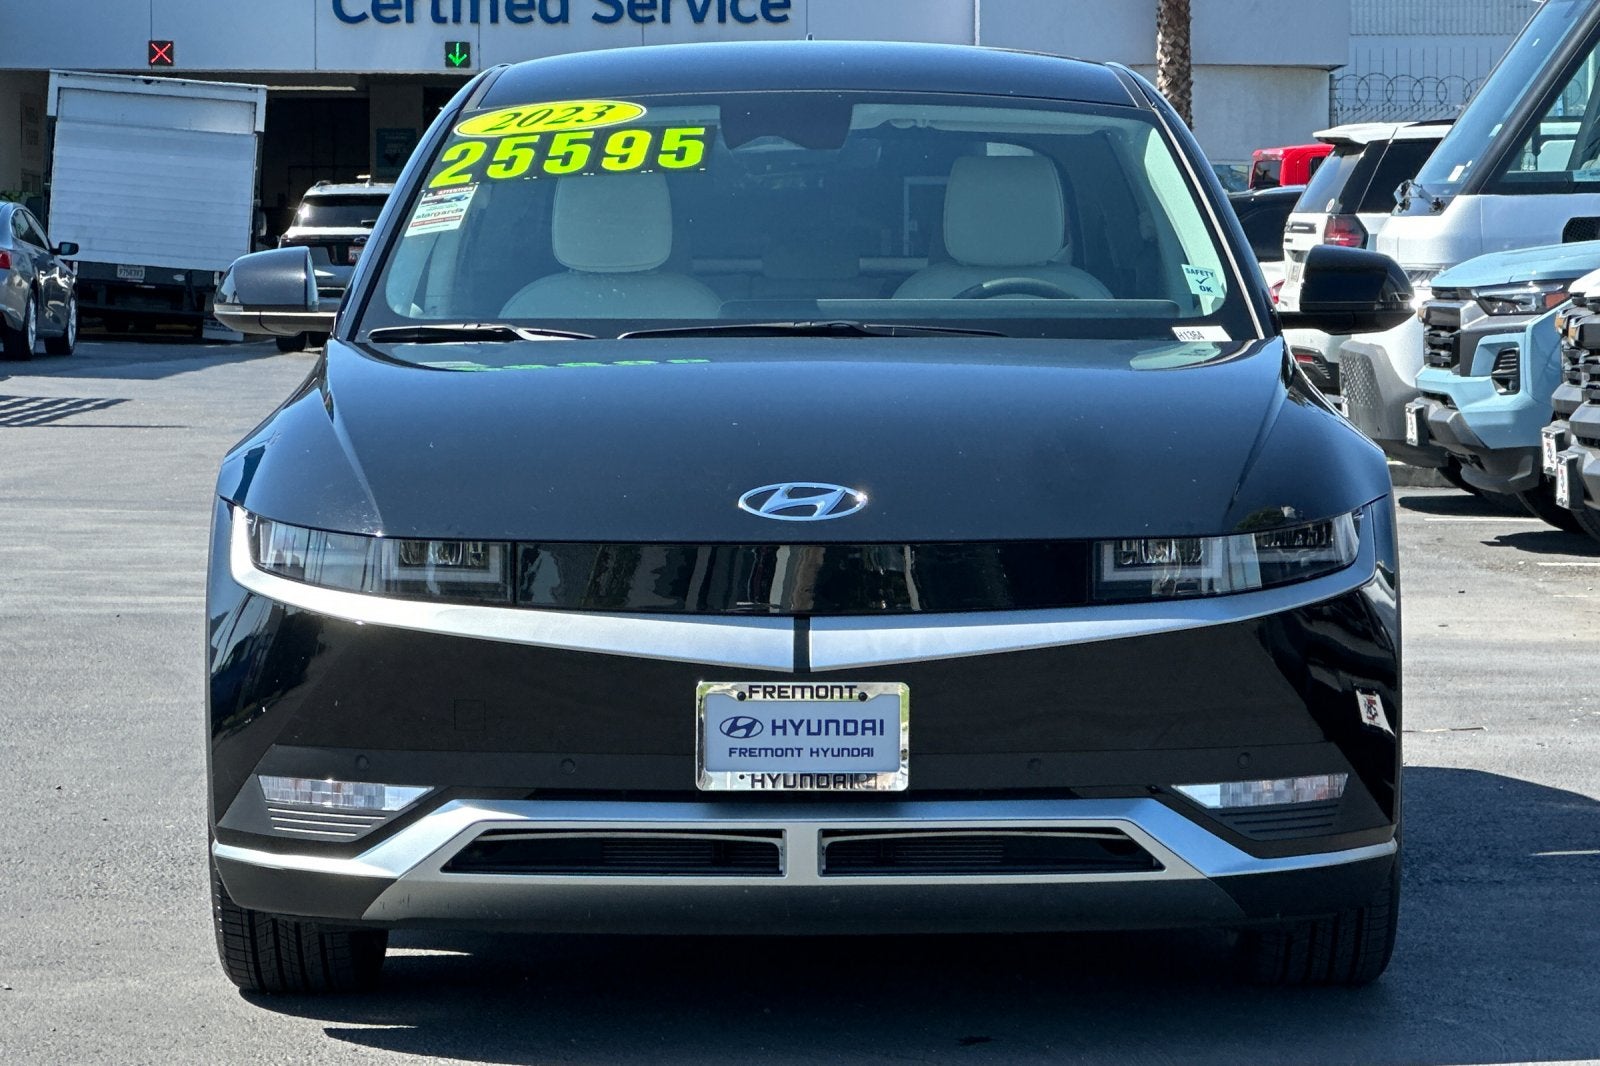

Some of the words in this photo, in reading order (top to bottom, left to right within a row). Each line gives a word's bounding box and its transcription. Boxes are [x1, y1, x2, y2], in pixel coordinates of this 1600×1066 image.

[591, 0, 792, 24] Service
[482, 104, 617, 132] 2023
[429, 128, 706, 188] 25595
[1185, 267, 1214, 277] SAFETY
[1199, 285, 1213, 293] OK
[748, 685, 857, 700] FREMONT
[771, 719, 885, 736] HYUNDAI
[728, 747, 804, 758] FREMONT
[810, 747, 874, 758] HYUNDAI
[750, 773, 854, 789] HYUNDAI
